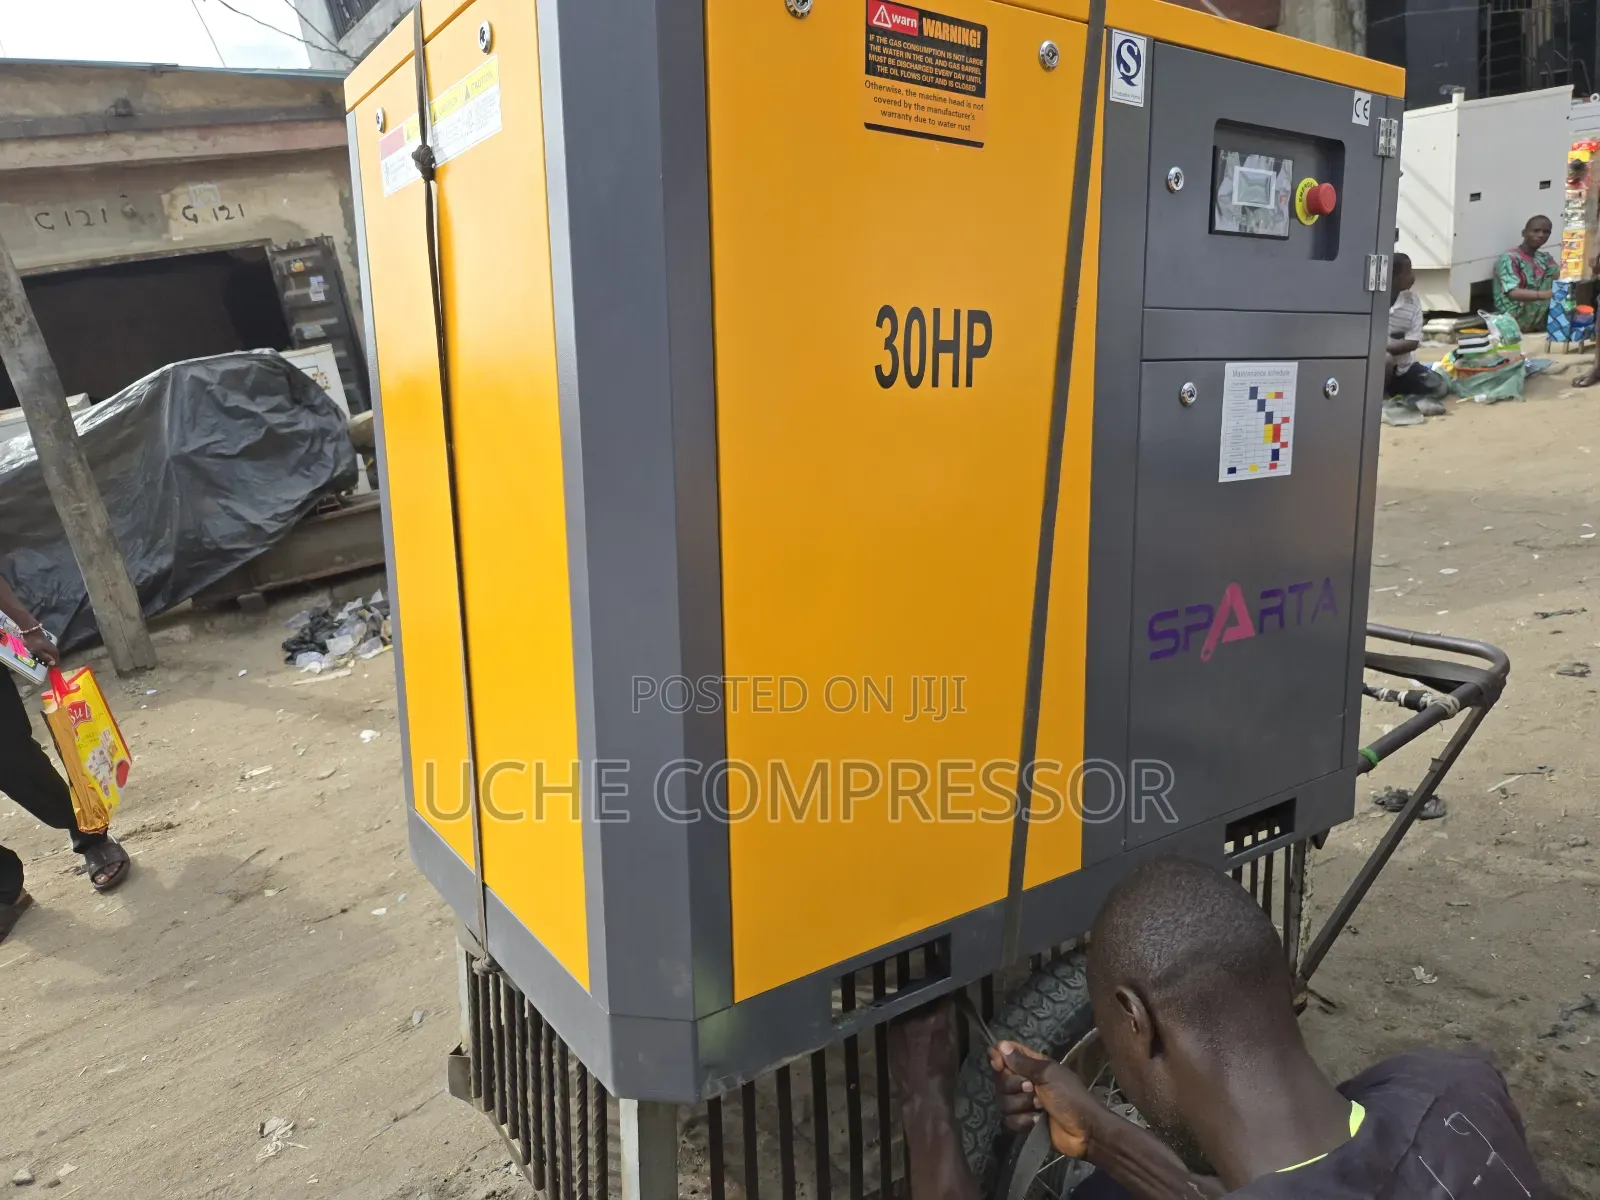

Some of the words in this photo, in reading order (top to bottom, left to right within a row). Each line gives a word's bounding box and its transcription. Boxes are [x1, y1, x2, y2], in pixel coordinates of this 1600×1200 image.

[892, 14, 916, 28] warn
[923, 18, 981, 48] WARNING!
[870, 44, 881, 53] THE
[883, 46, 904, 58] WATER
[913, 54, 923, 62] THE
[935, 59, 947, 67] AND
[949, 62, 960, 70] GAS
[961, 64, 981, 75] BARREL
[876, 36, 888, 44] THE
[889, 38, 902, 47] GAS
[903, 42, 946, 57] CONSUMPTION
[953, 53, 965, 62] NOT
[966, 56, 983, 66] LARGE
[869, 54, 887, 63] MUST
[897, 60, 934, 73] DISCHARGED
[935, 68, 953, 78] EVERY
[954, 72, 965, 80] DAY
[966, 75, 982, 84] UNTIL
[877, 65, 888, 73] THE
[890, 68, 899, 76] OIL
[901, 70, 920, 80] FLOWS
[922, 75, 934, 83] OUT
[935, 78, 947, 86] AND
[955, 82, 976, 92] CLOSED
[865, 80, 903, 96] Otherwise,
[906, 89, 916, 97] the
[919, 92, 947, 104] machine
[949, 97, 964, 107] head
[874, 96, 901, 107] covered
[904, 100, 912, 111] by
[914, 103, 925, 111] the
[927, 106, 976, 120] manufacturer's
[881, 110, 912, 123] warranty
[914, 115, 926, 124] due
[937, 120, 956, 128] water
[1354, 98, 1370, 120] CE
[875, 304, 992, 389] 30HP
[1232, 370, 1267, 378] Maintenance
[1148, 577, 1338, 662] SPARTA
